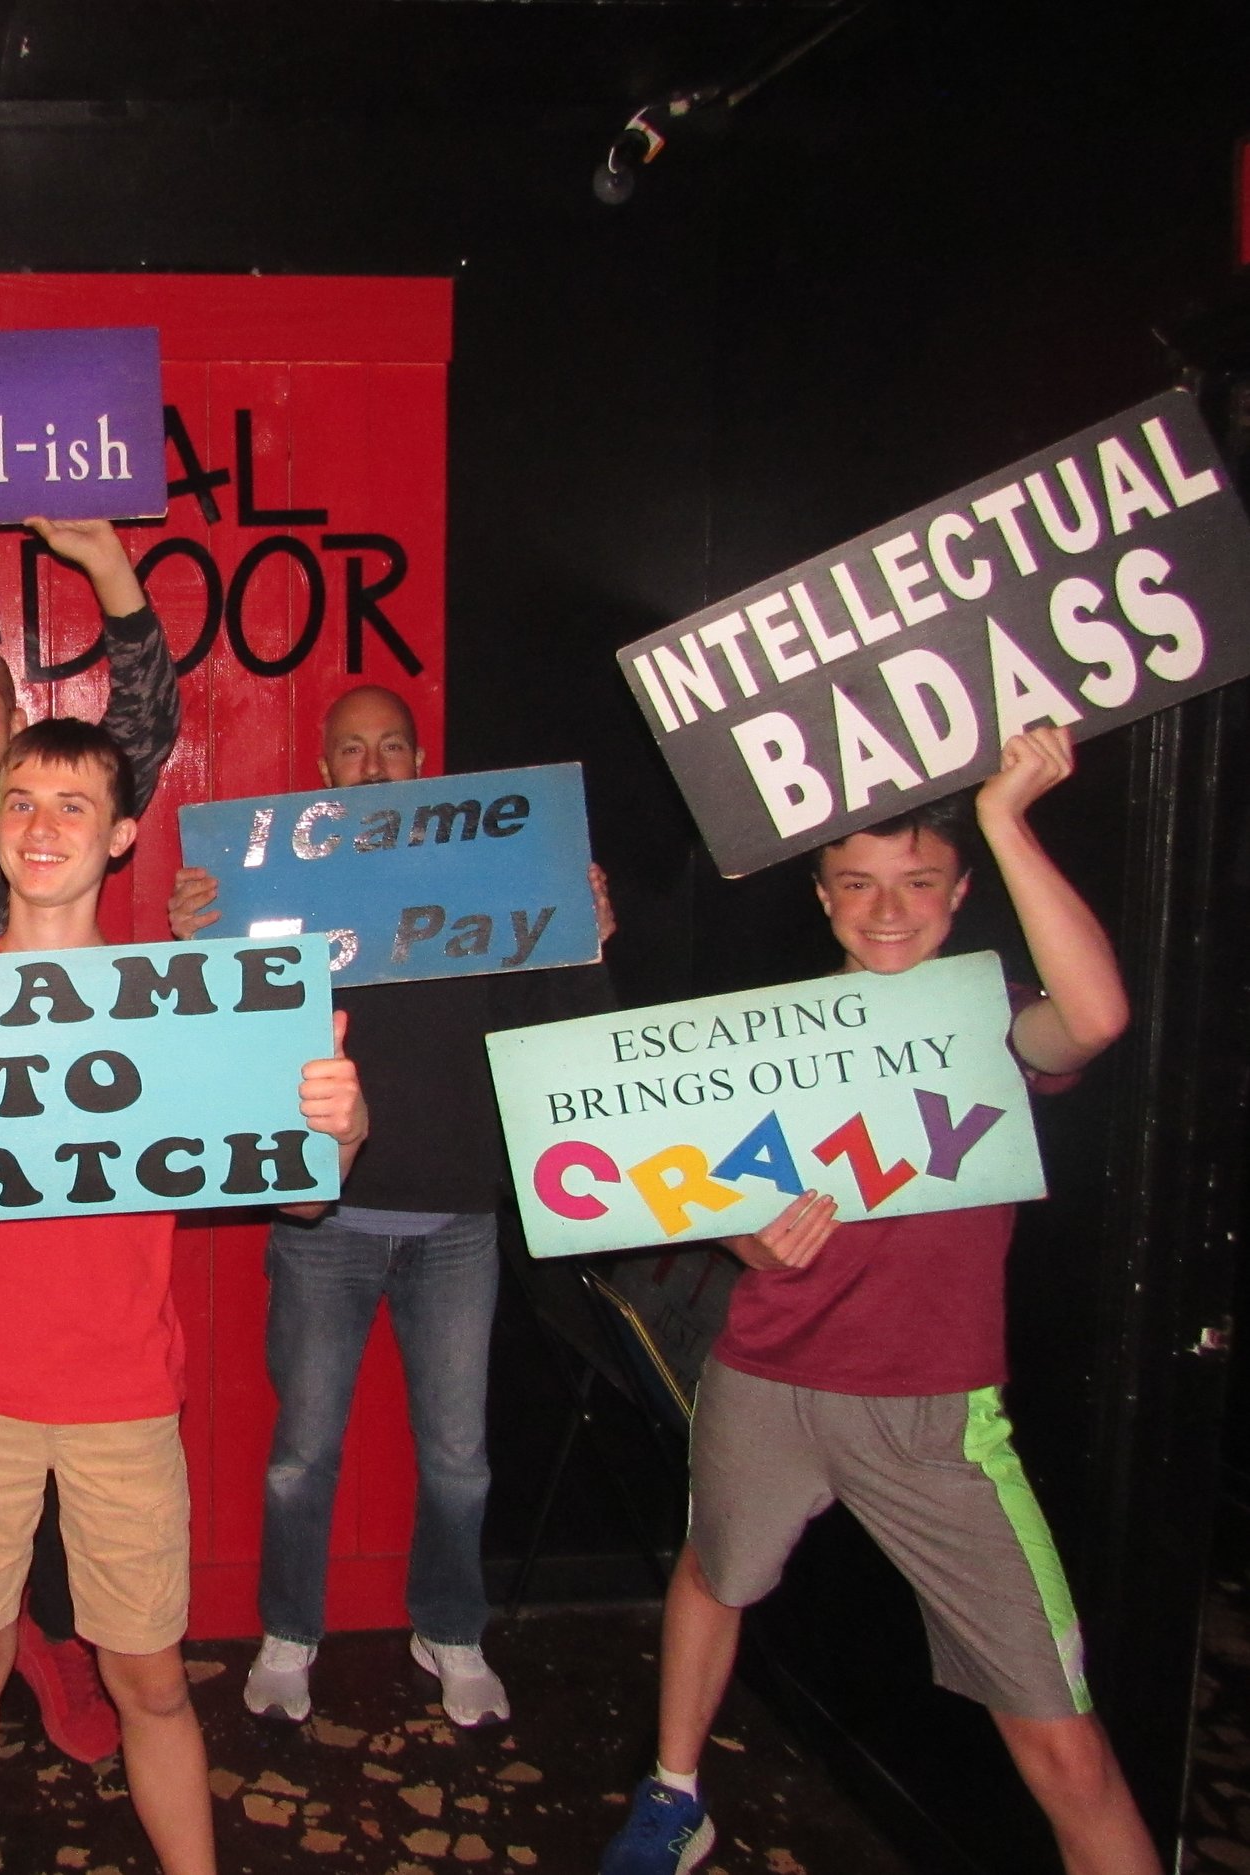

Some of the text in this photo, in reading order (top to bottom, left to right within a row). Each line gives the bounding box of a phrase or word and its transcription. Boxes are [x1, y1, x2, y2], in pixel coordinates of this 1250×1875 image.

[632, 415, 1221, 733] INTELLECTUAL
[729, 548, 1206, 839] BADASS
[244, 794, 531, 868] I Came
[390, 905, 557, 967] Pay
[609, 992, 869, 1064] ESCAPING
[546, 1034, 959, 1125] BRINGS OUT MY
[533, 1088, 1007, 1238] CRAZY
